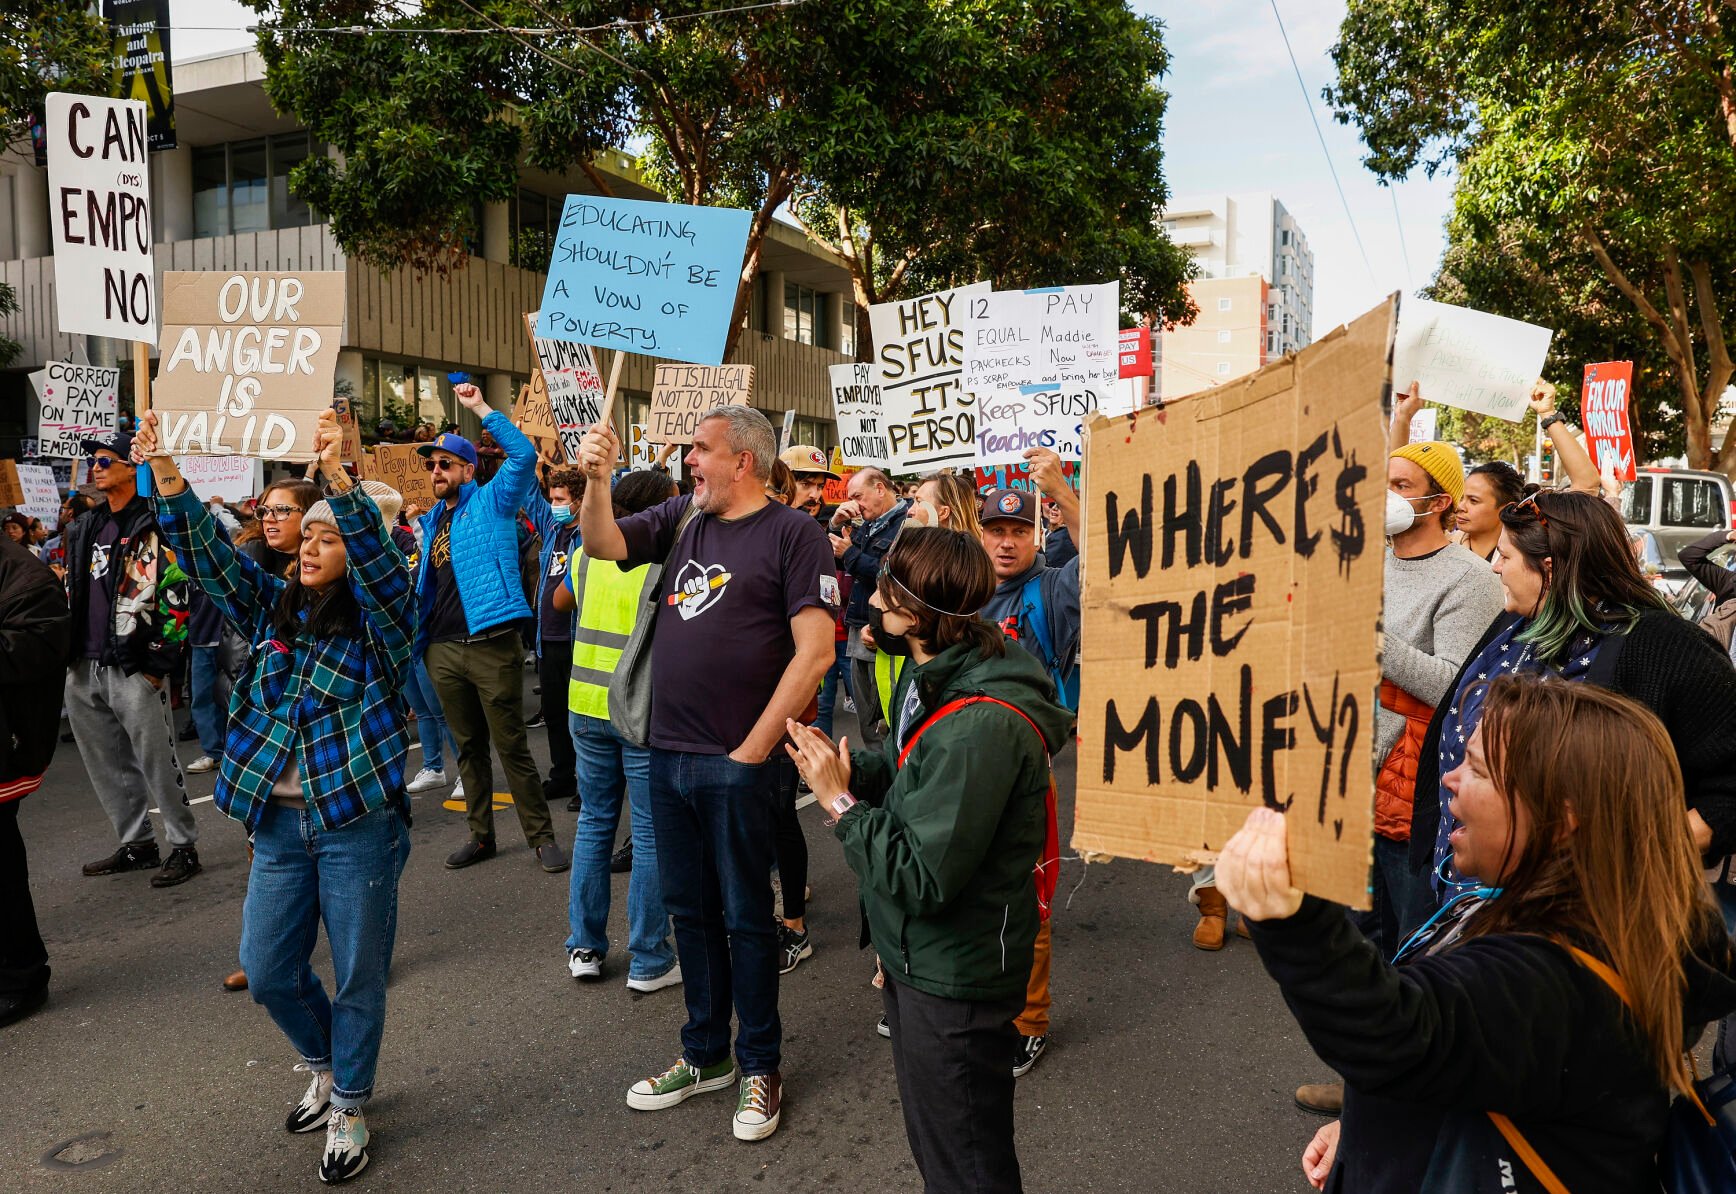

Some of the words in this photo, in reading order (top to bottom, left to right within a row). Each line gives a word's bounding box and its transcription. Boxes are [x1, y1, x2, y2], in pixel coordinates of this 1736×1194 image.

[116, 20, 156, 37] Antony
[127, 35, 147, 52] and
[112, 51, 165, 69] Cleopatra
[68, 102, 145, 163] CAN
[116, 171, 143, 188] (DYS)
[60, 187, 149, 255] EMPO
[562, 203, 696, 247] EDUCATING
[558, 238, 676, 279] SHOULDN'T
[688, 264, 720, 288] BE
[104, 267, 150, 325] NO
[218, 274, 304, 324] OUR
[552, 279, 569, 299] A
[594, 285, 641, 311] VOW
[661, 302, 689, 318] OF
[1046, 293, 1094, 315] PAY
[898, 293, 956, 337] HEY
[969, 298, 991, 320] 12
[549, 311, 661, 350] POVERTY.
[977, 327, 1030, 347] EQUAL
[1040, 325, 1096, 345] Maddie
[166, 325, 322, 376] ANGER
[536, 340, 592, 371] HUMAN
[881, 329, 963, 380] SFUS
[1119, 342, 1137, 351] PAY
[970, 356, 1031, 374] PAYCHECKS
[1122, 356, 1135, 364] US
[49, 364, 118, 388] CORRECT
[698, 366, 747, 391] ILLEGAL
[854, 364, 870, 384] PAY
[983, 373, 1008, 384] SCRAP
[997, 380, 1033, 389] EMPOWER
[1042, 374, 1057, 382] and
[1062, 372, 1086, 383] bring
[1089, 370, 1100, 379] her
[66, 386, 103, 408] PAY
[216, 374, 262, 418] IS
[655, 390, 684, 409] NOT
[686, 390, 703, 409] TO
[709, 390, 737, 410] PAY
[835, 385, 882, 405] EMPLOYE
[1587, 381, 1604, 412] FIX
[1604, 379, 1626, 412] OUR
[42, 405, 64, 422] ON
[72, 409, 114, 427] TIME
[551, 393, 601, 426] HUMAN
[978, 395, 1026, 427] Keep
[161, 412, 297, 458] VALID
[654, 412, 704, 436] TEACH
[860, 418, 877, 433] NOT
[888, 412, 975, 456] PERSO
[1586, 410, 1626, 437] PAYROLL
[843, 436, 888, 461] CONSULTAN
[976, 426, 1057, 457] Teachers
[1058, 440, 1072, 453] in
[380, 446, 406, 476] Pay
[827, 488, 848, 500] TEACH
[1129, 573, 1255, 669] THE
[1102, 664, 1359, 841] MONEY?
